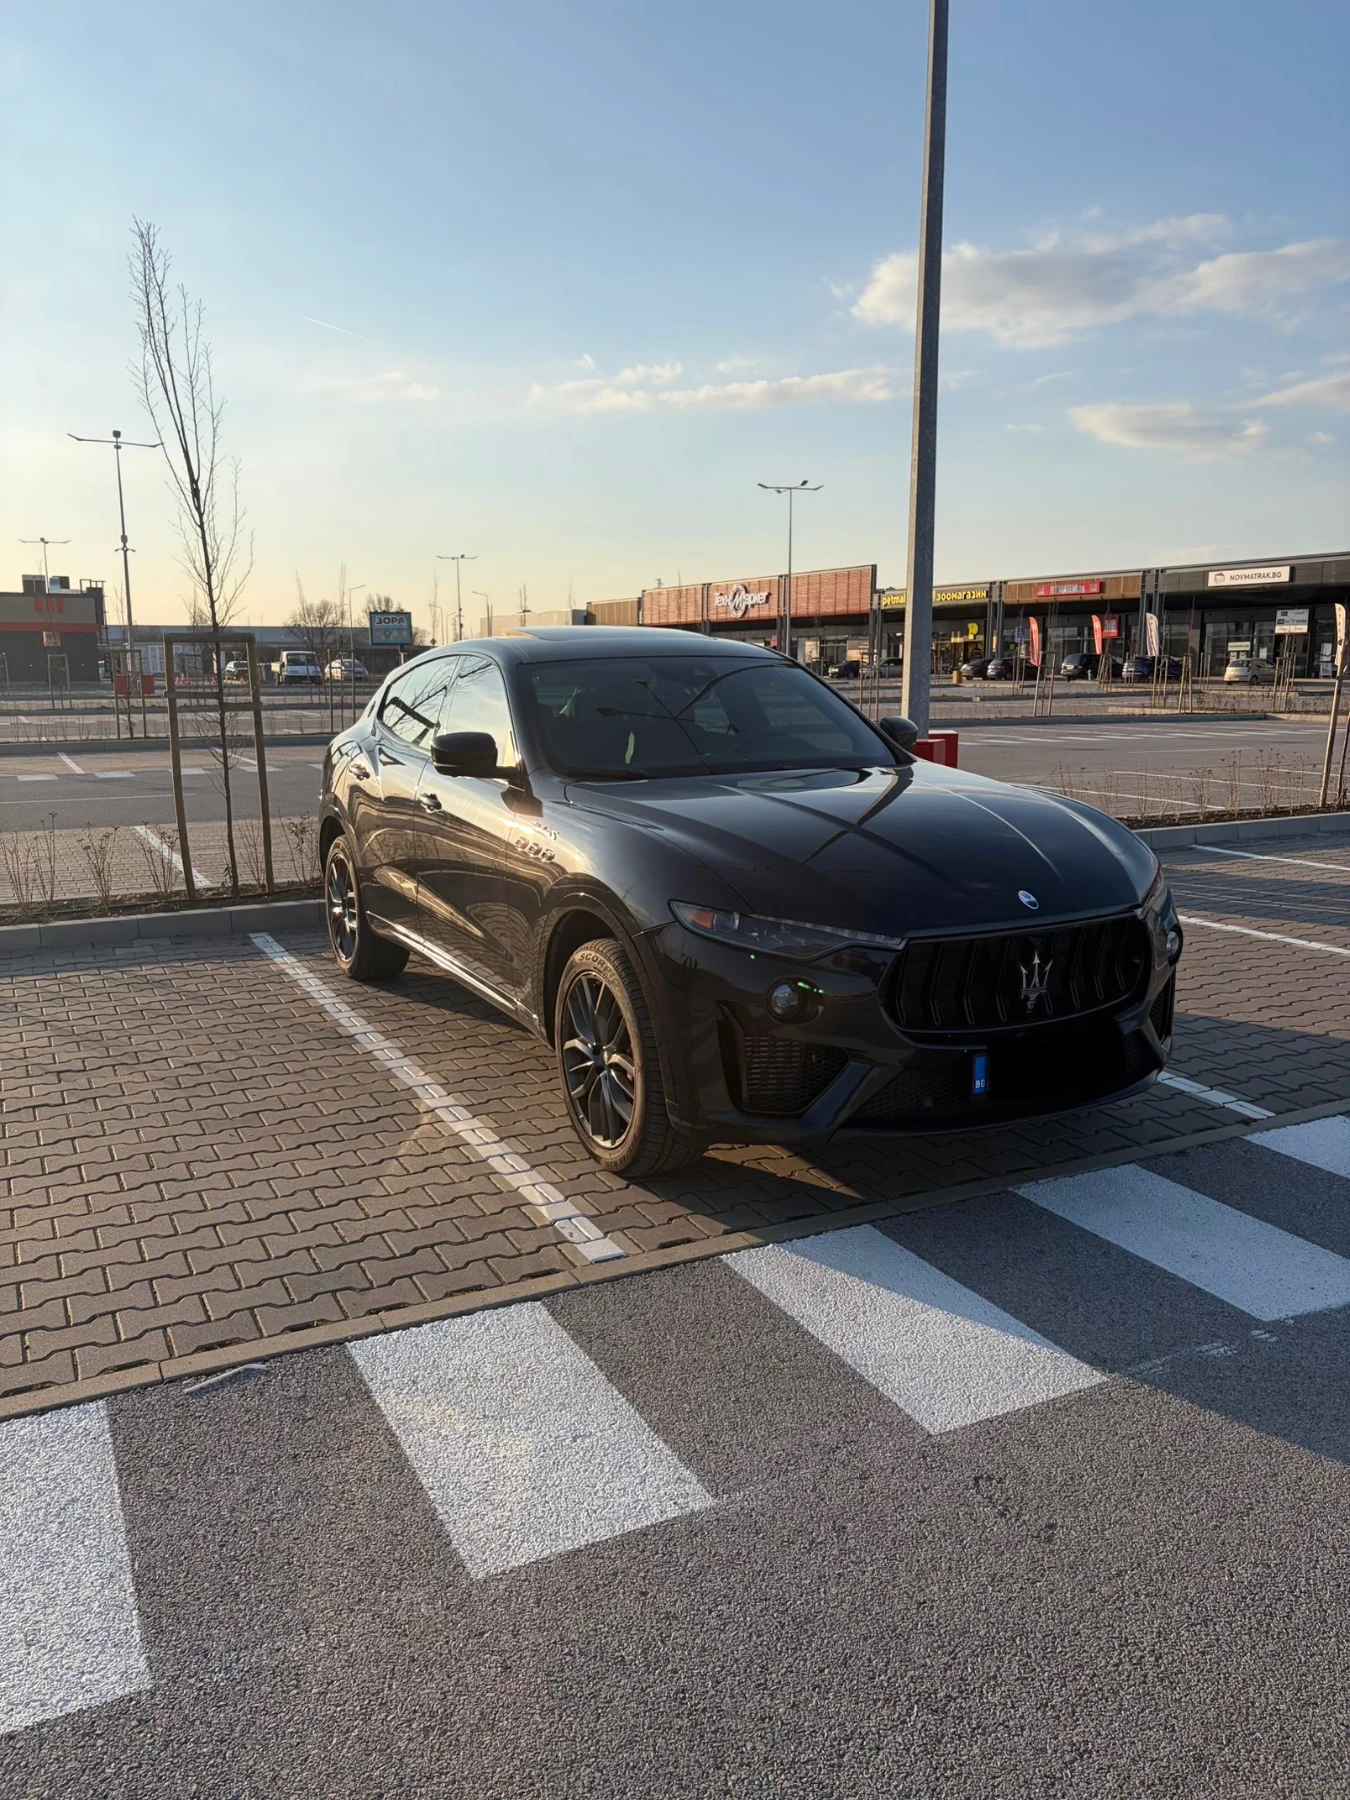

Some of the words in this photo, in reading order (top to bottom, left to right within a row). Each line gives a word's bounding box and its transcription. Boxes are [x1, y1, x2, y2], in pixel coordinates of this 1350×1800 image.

[1230, 571, 1282, 581] NOVMATRAK.BG
[882, 593, 906, 605] petmal
[936, 590, 987, 601] зоомагазин
[375, 616, 407, 625] ЗОРА
[975, 1079, 986, 1089] BG
